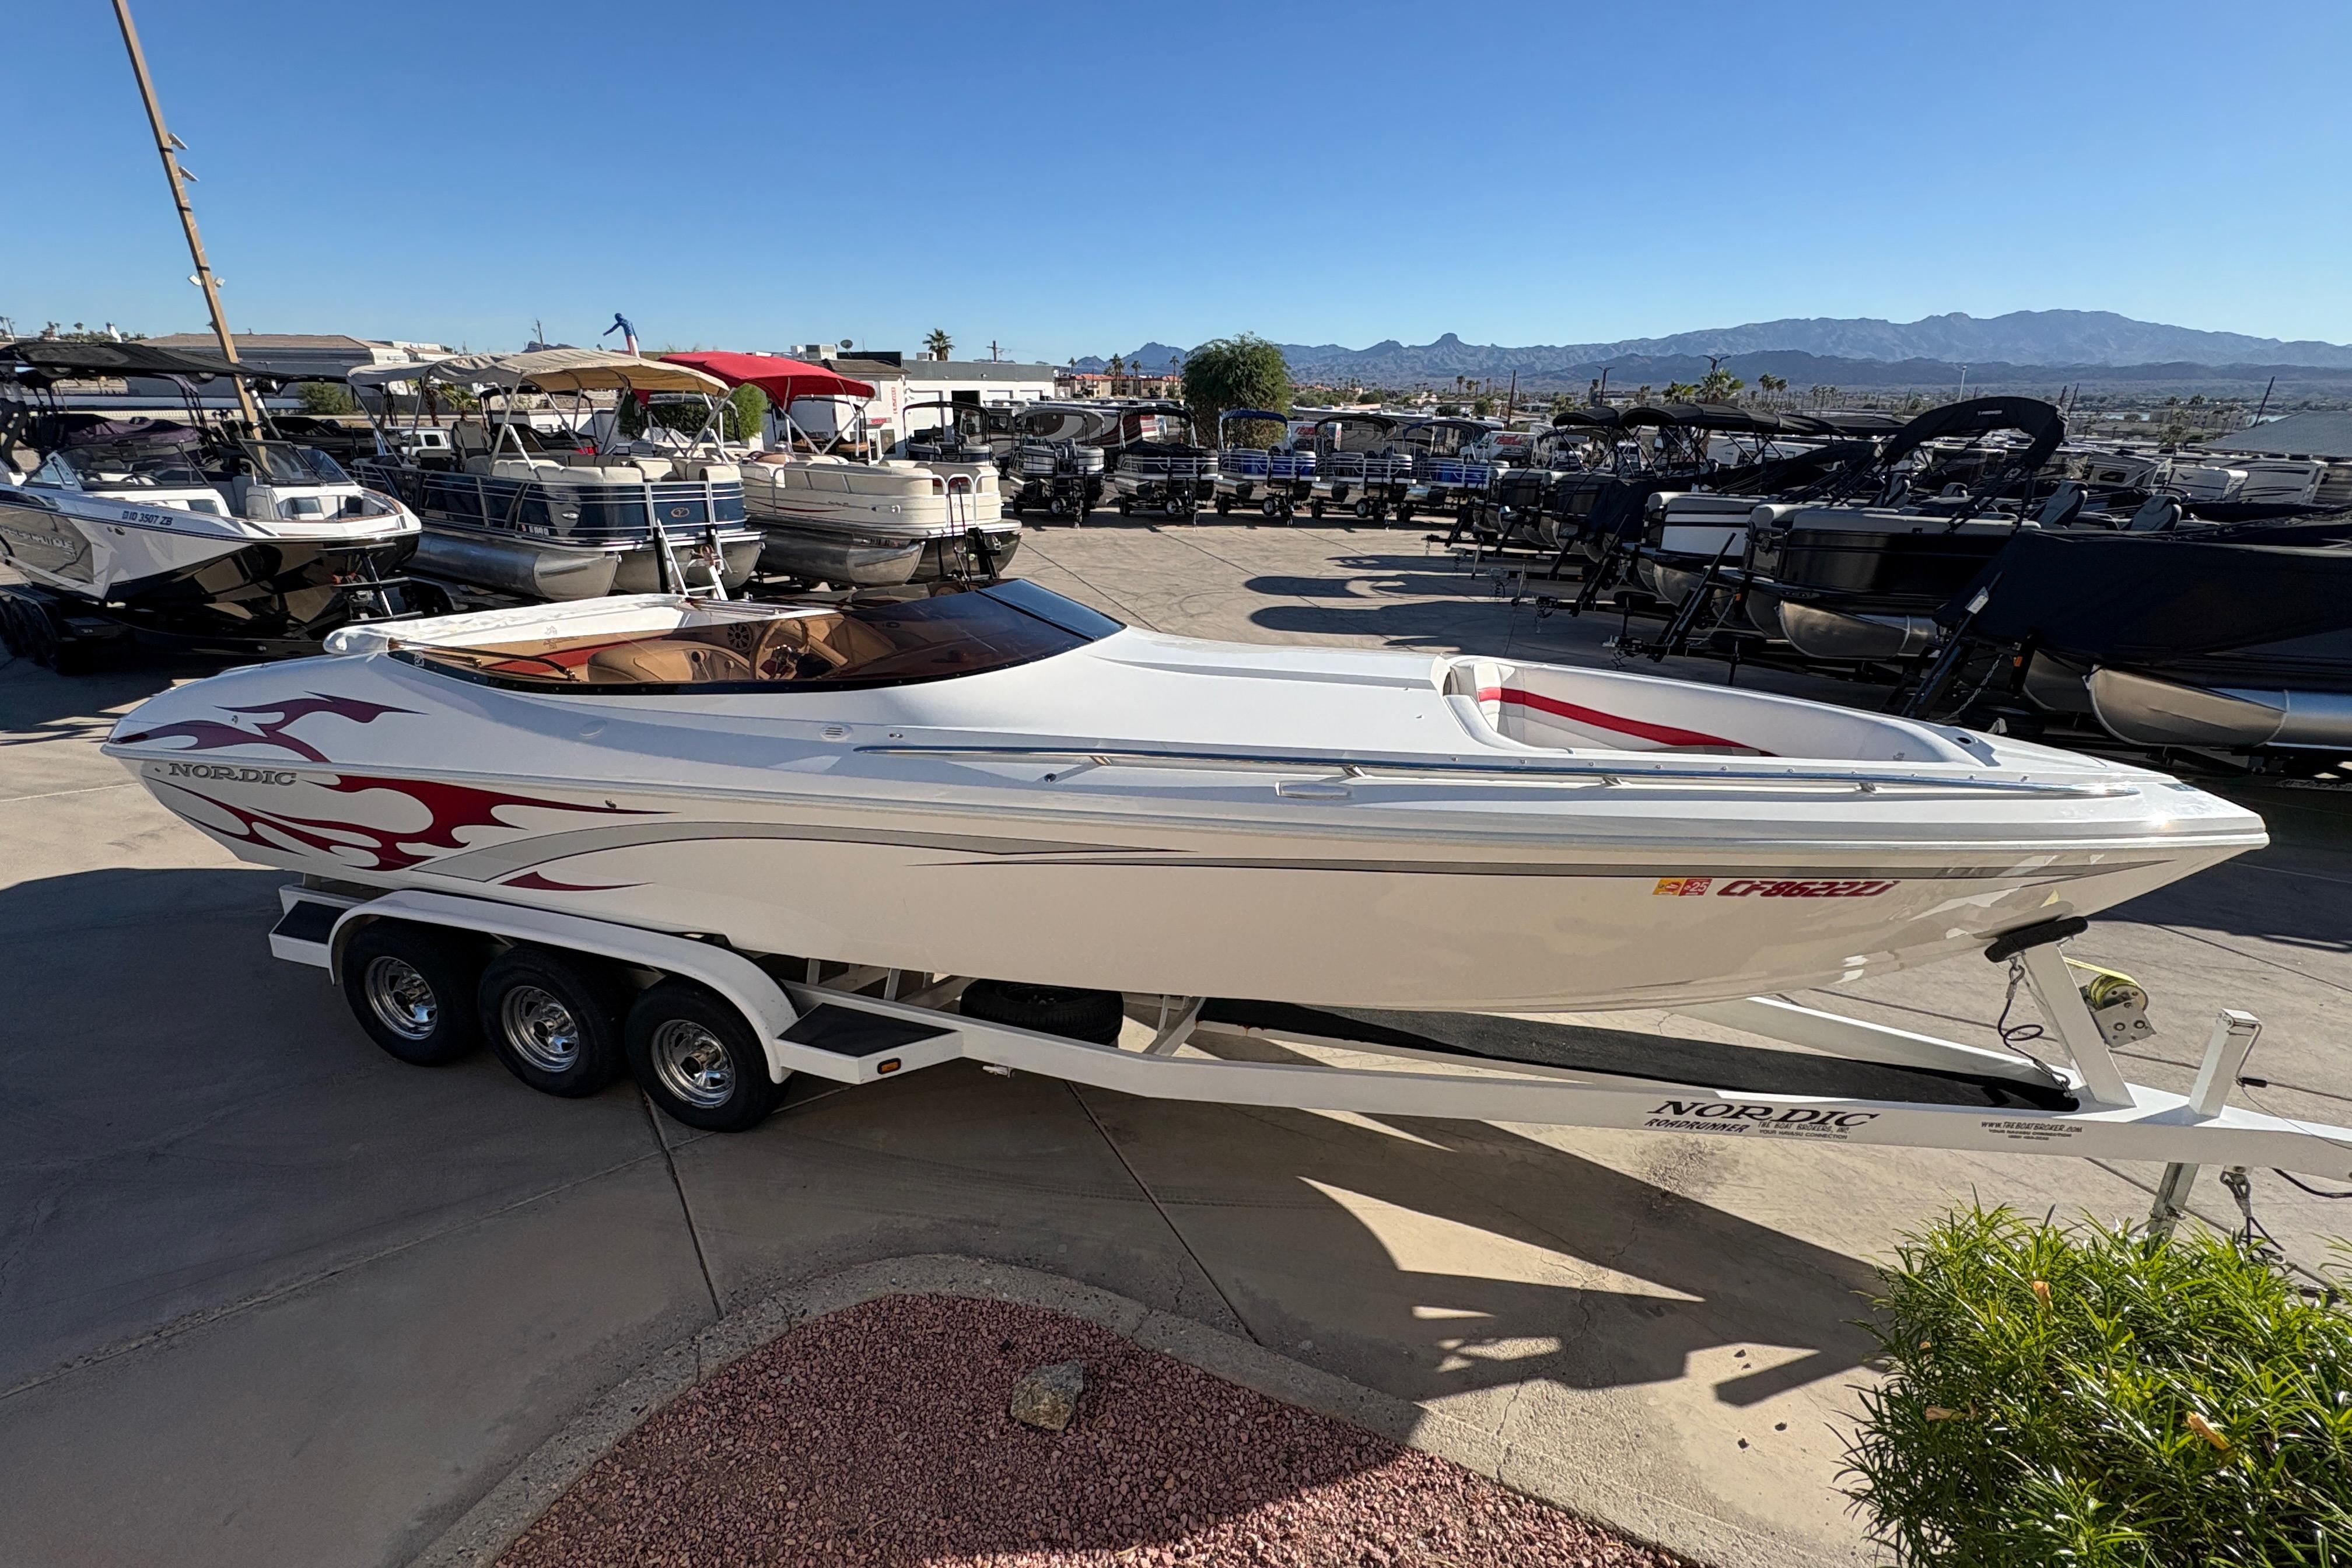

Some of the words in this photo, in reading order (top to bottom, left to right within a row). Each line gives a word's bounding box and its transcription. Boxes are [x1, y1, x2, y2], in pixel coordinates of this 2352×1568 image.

[129, 512, 138, 520] ID
[138, 513, 159, 524] 3507
[159, 516, 173, 526] ZB
[169, 763, 297, 786] NORDIC
[1689, 881, 1709, 892] 25
[1646, 1101, 1881, 1126] NORDIC
[1644, 1118, 1751, 1133] ROADRUNNER
